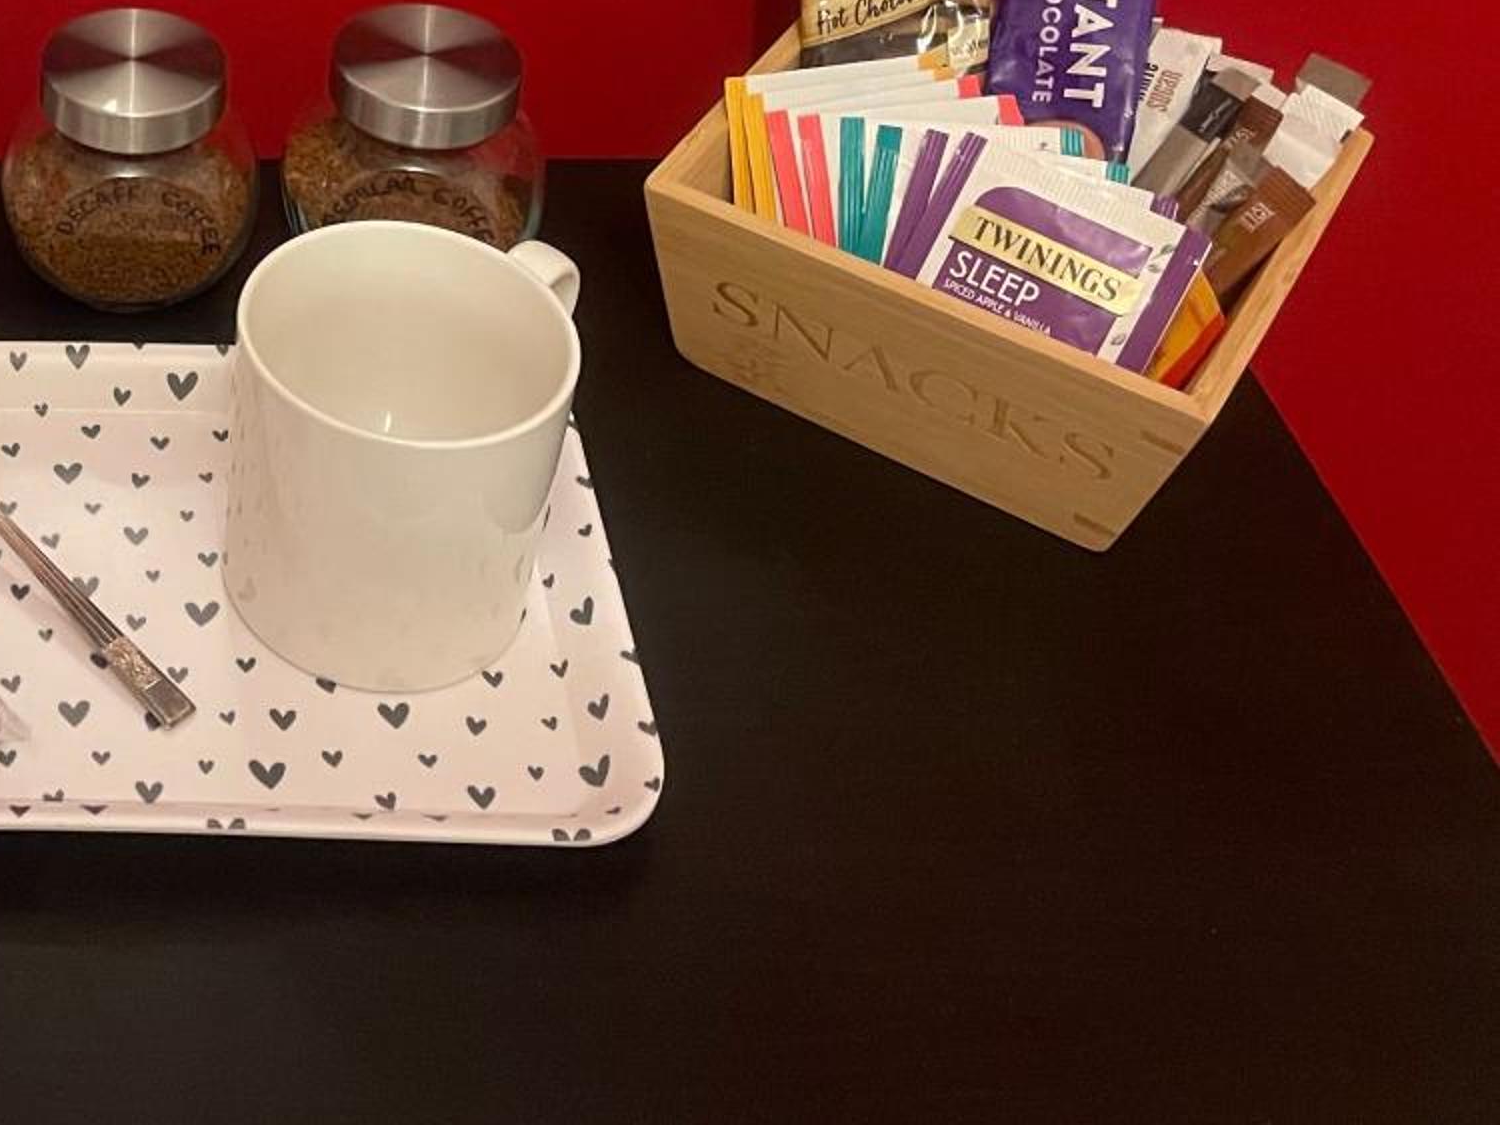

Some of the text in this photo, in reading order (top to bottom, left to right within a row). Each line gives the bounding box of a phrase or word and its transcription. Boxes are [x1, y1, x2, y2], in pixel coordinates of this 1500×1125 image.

[55, 183, 222, 255] DECAFF COFFEE
[949, 250, 1041, 307] SLEEP
[972, 215, 1122, 303] TWININGS
[943, 277, 976, 300] SPICED
[975, 294, 1005, 314] APPLE
[711, 279, 1116, 481] SNACKS
